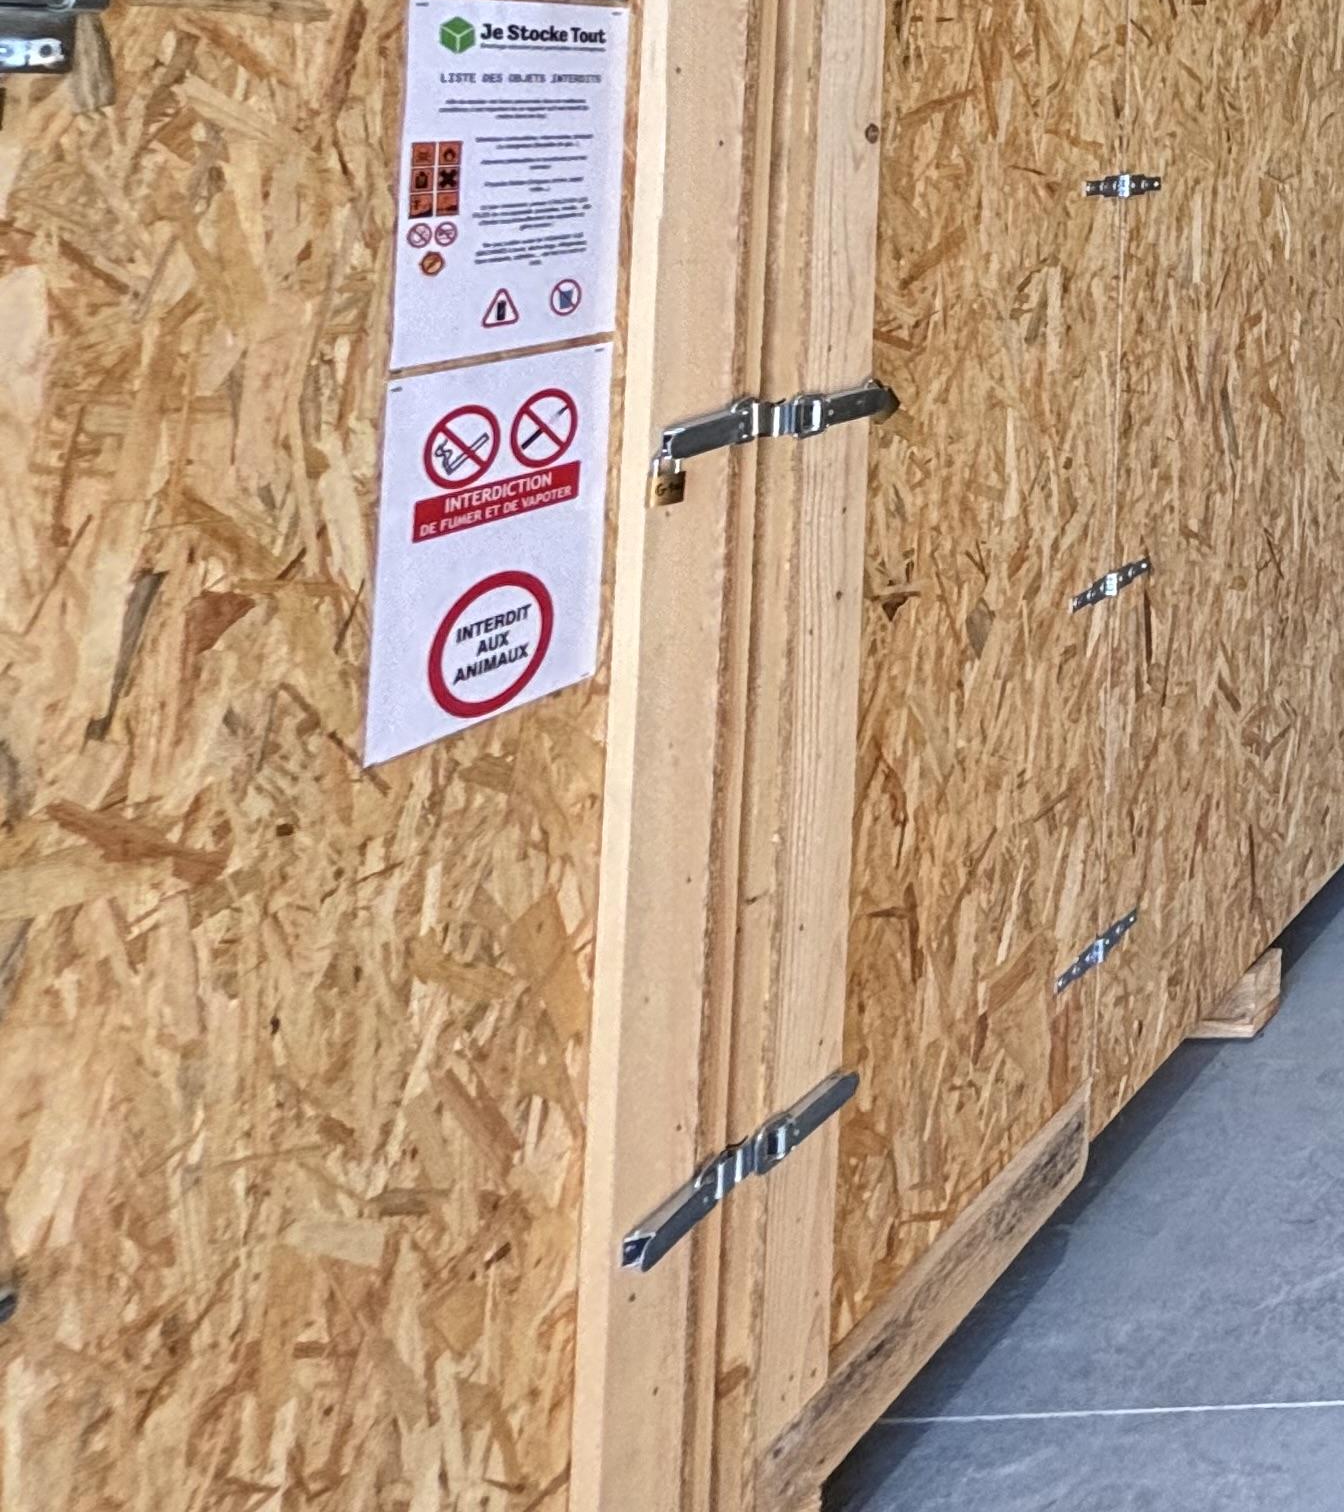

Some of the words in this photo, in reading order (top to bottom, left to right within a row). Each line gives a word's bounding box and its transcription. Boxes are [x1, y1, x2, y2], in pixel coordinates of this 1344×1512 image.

[480, 23, 504, 40] Je
[507, 24, 568, 42] Stocke
[570, 26, 607, 44] Tout
[440, 72, 477, 84] LISTE
[481, 73, 503, 84] DES
[419, 521, 437, 538] DE
[440, 509, 482, 532] FUMER
[485, 504, 501, 519] ET
[503, 499, 519, 514] DE
[521, 484, 572, 508] VAPOTER
[444, 471, 553, 514] INTERDICTION
[456, 603, 532, 644] INTERDIT
[476, 629, 510, 657] AUX
[453, 641, 529, 686] ANIMAUX
